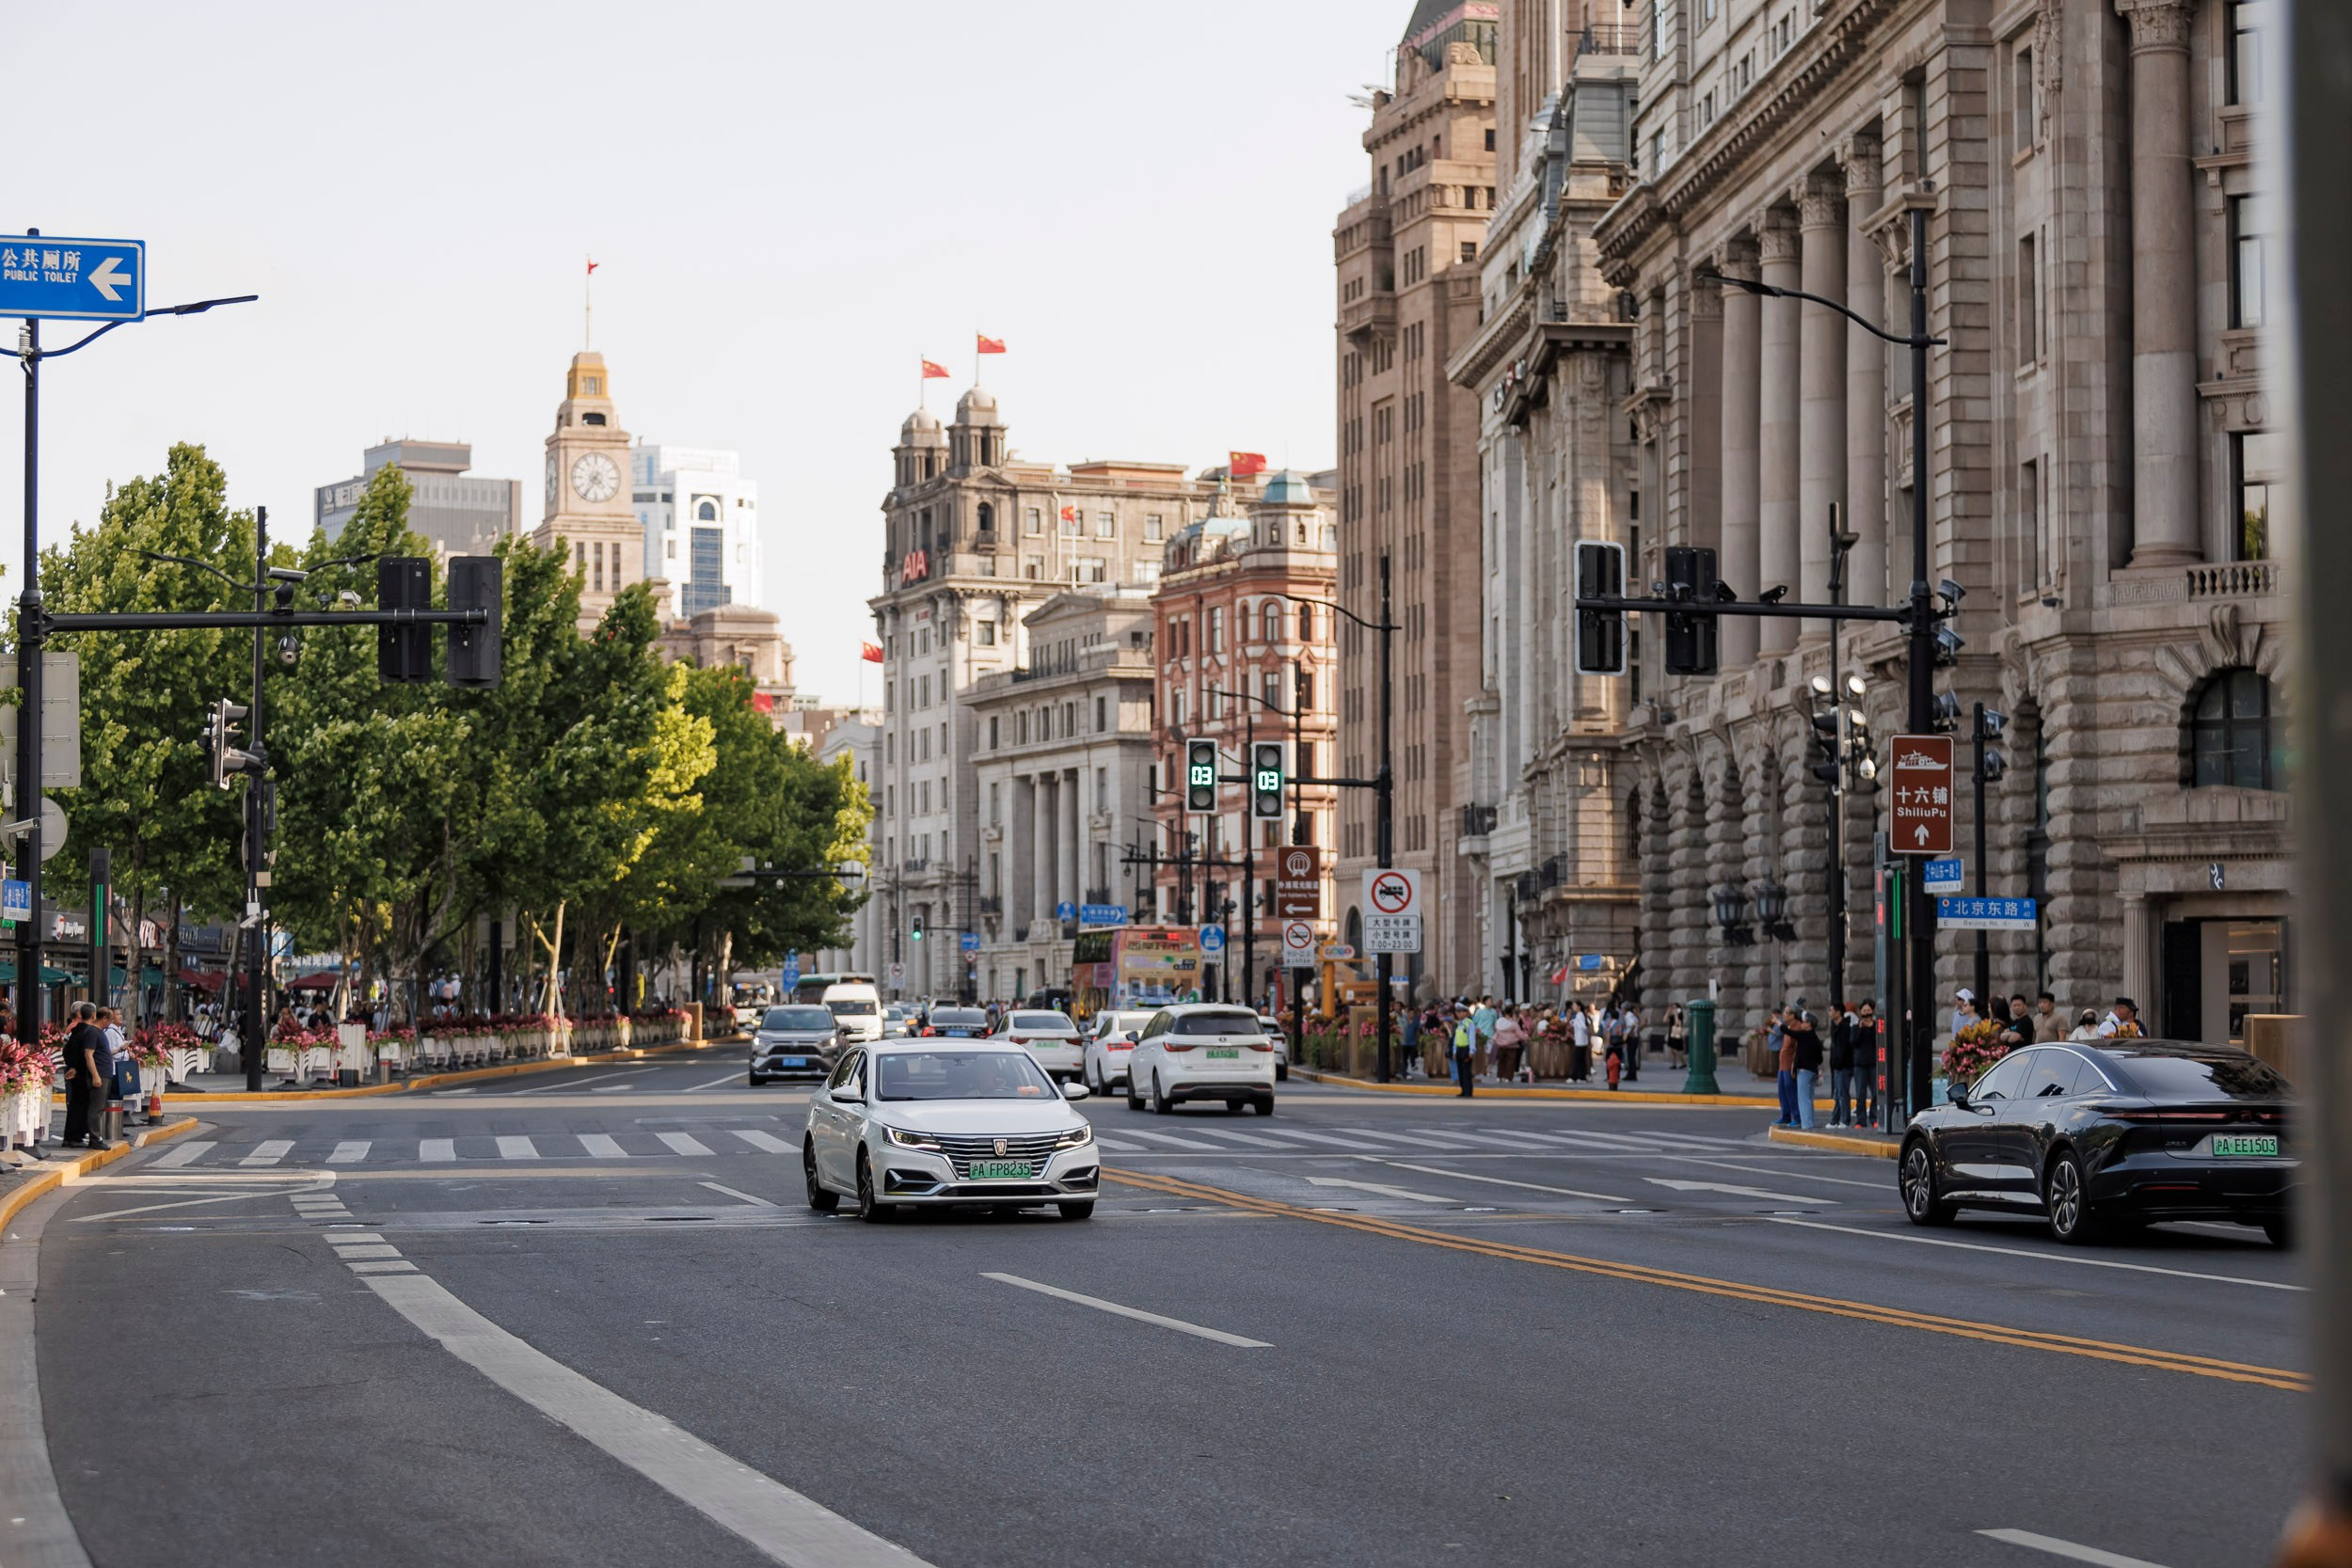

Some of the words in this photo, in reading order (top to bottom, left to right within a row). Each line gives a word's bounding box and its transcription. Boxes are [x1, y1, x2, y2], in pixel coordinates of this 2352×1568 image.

[4, 269, 39, 281] PUBLIC
[44, 271, 78, 283] TOILET
[903, 549, 929, 583] AIA
[1191, 766, 1213, 785] 03
[1258, 771, 1279, 790] 03
[1896, 785, 1948, 804] 十六铺
[1897, 806, 1947, 817] ShiliuPu
[1954, 900, 2018, 916] 北京东路
[1373, 918, 1410, 927] 大型号牌
[1373, 930, 1410, 940] 小型号牌
[2234, 1138, 2276, 1152] EE1503
[990, 1162, 1030, 1176] FP8235
